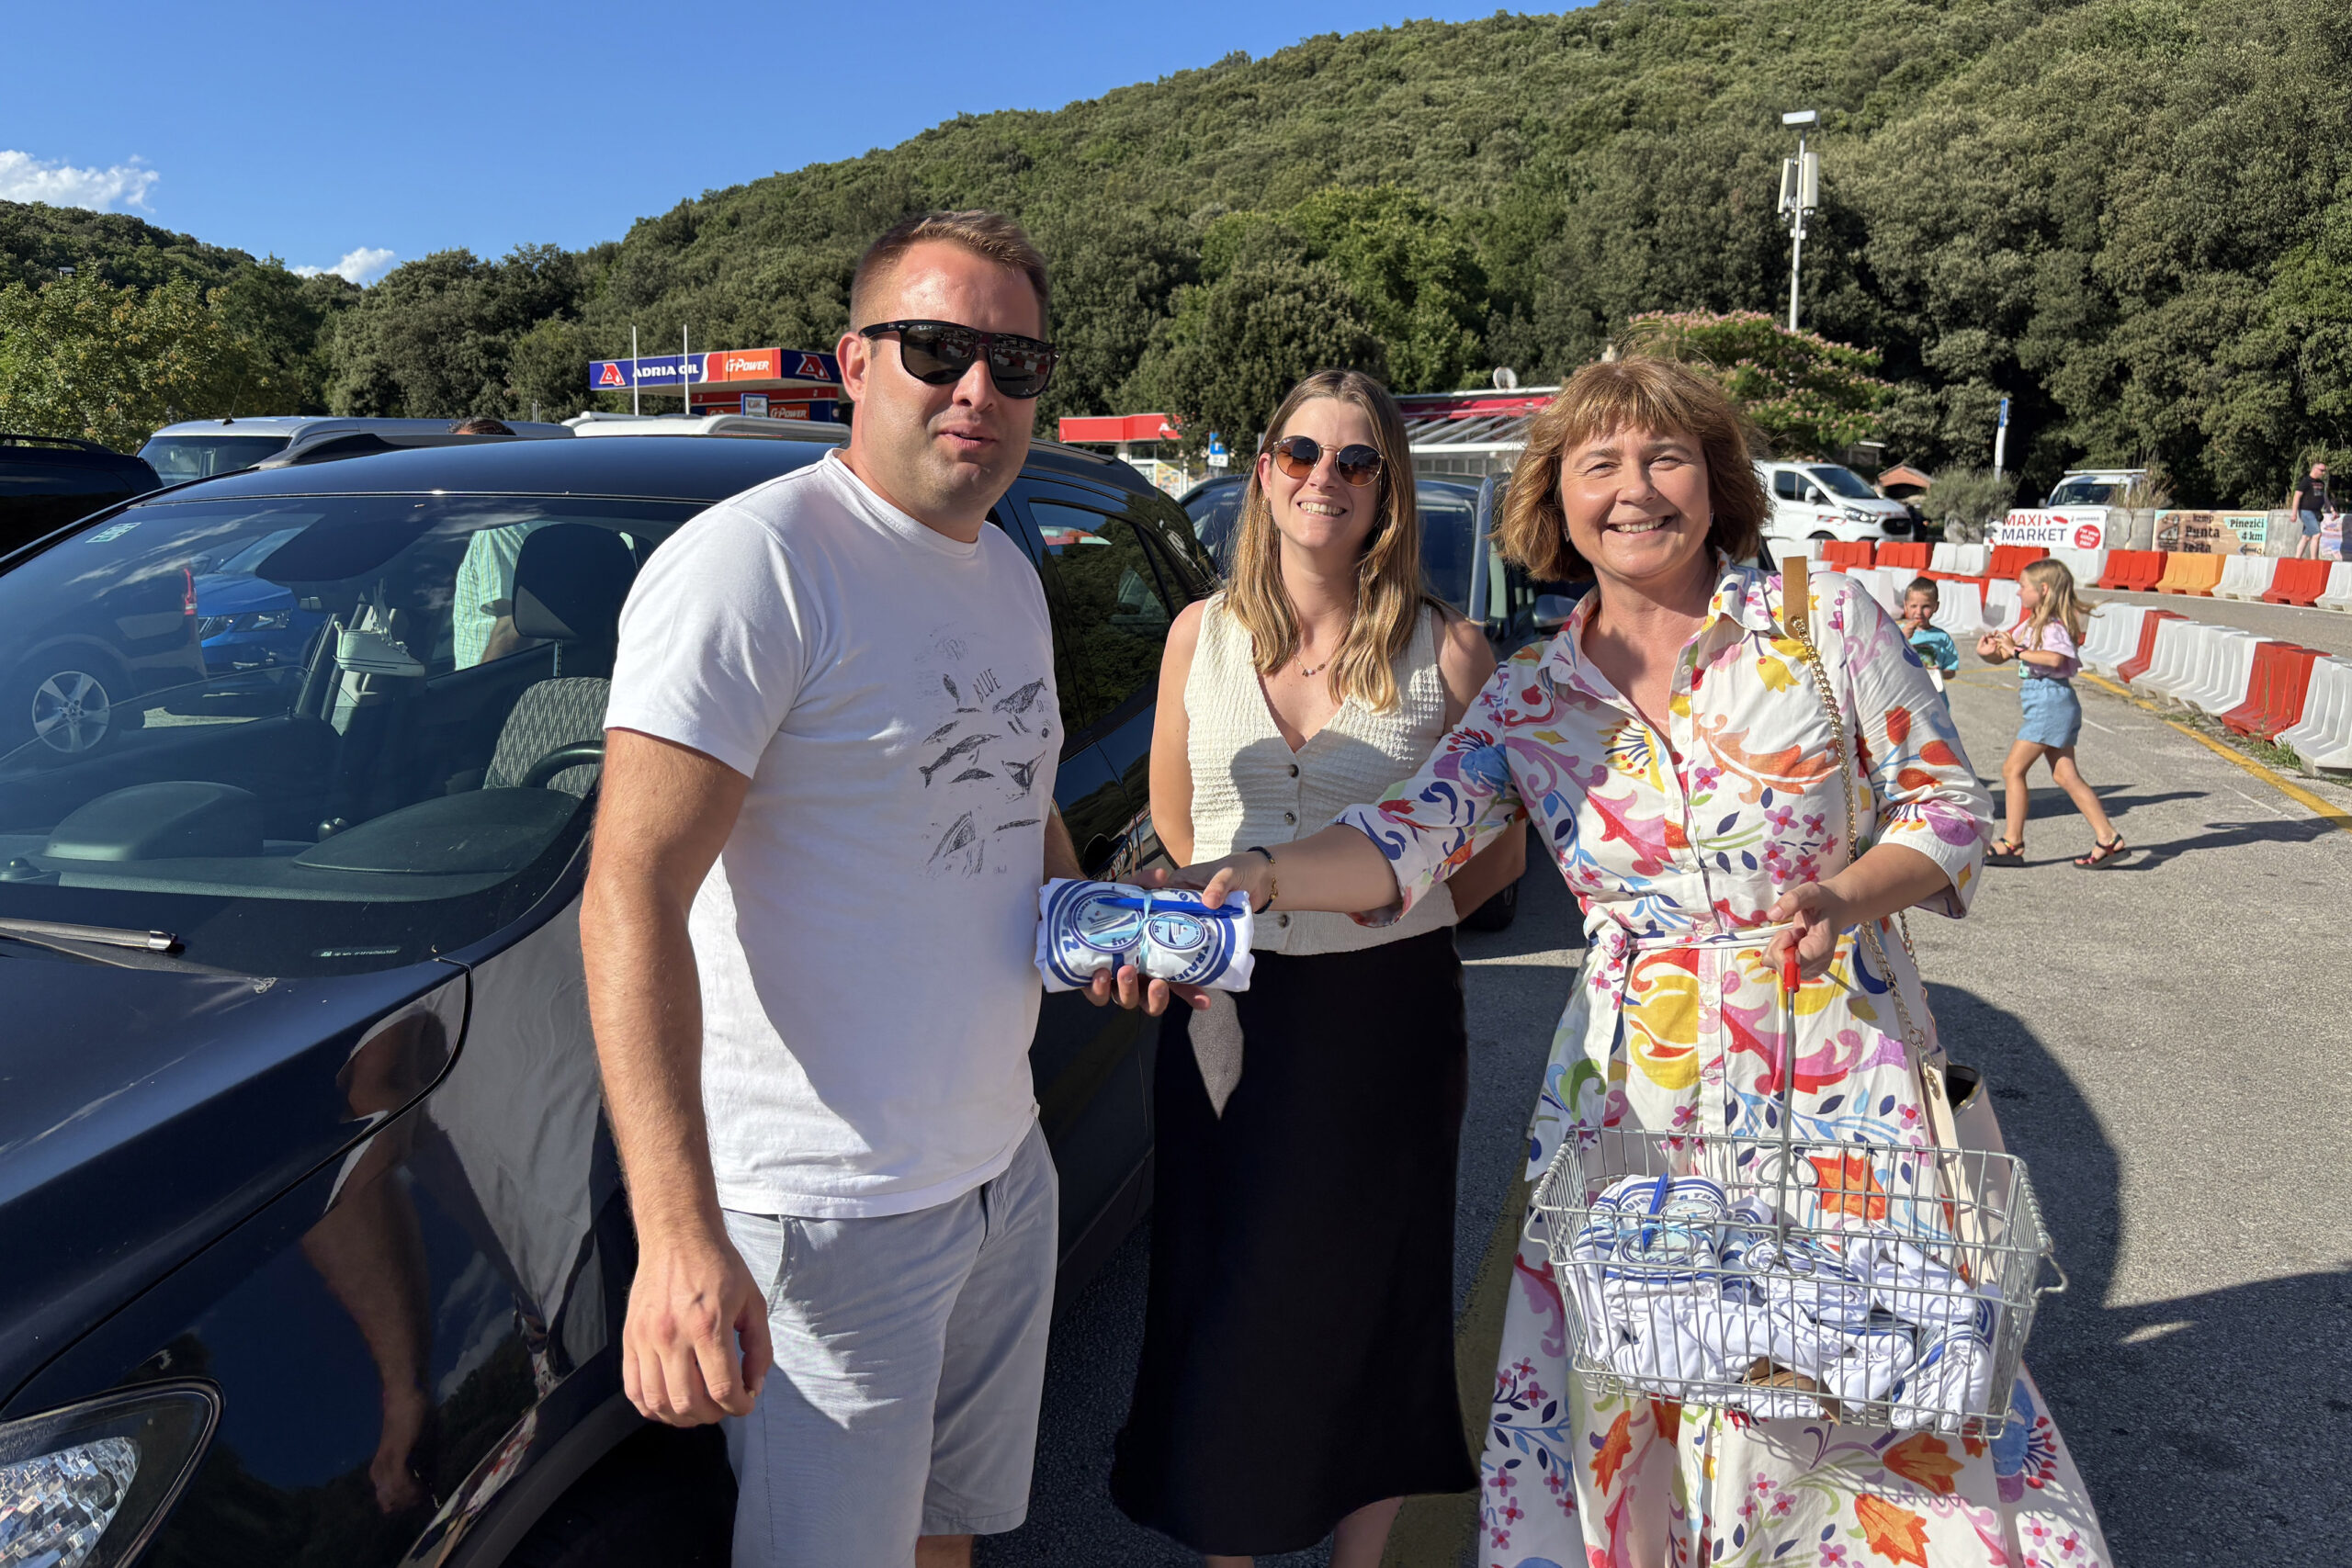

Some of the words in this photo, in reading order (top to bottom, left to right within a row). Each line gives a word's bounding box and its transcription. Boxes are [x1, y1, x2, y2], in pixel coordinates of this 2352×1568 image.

[632, 365, 676, 378] ADRIA
[678, 364, 699, 375] OIL
[2003, 514, 2041, 526] MAXI
[2001, 528, 2067, 541] MARKET
[2186, 525, 2220, 538] Punta
[2242, 531, 2247, 540] 4
[2249, 531, 2263, 541] km
[973, 668, 1001, 704] BLUE
